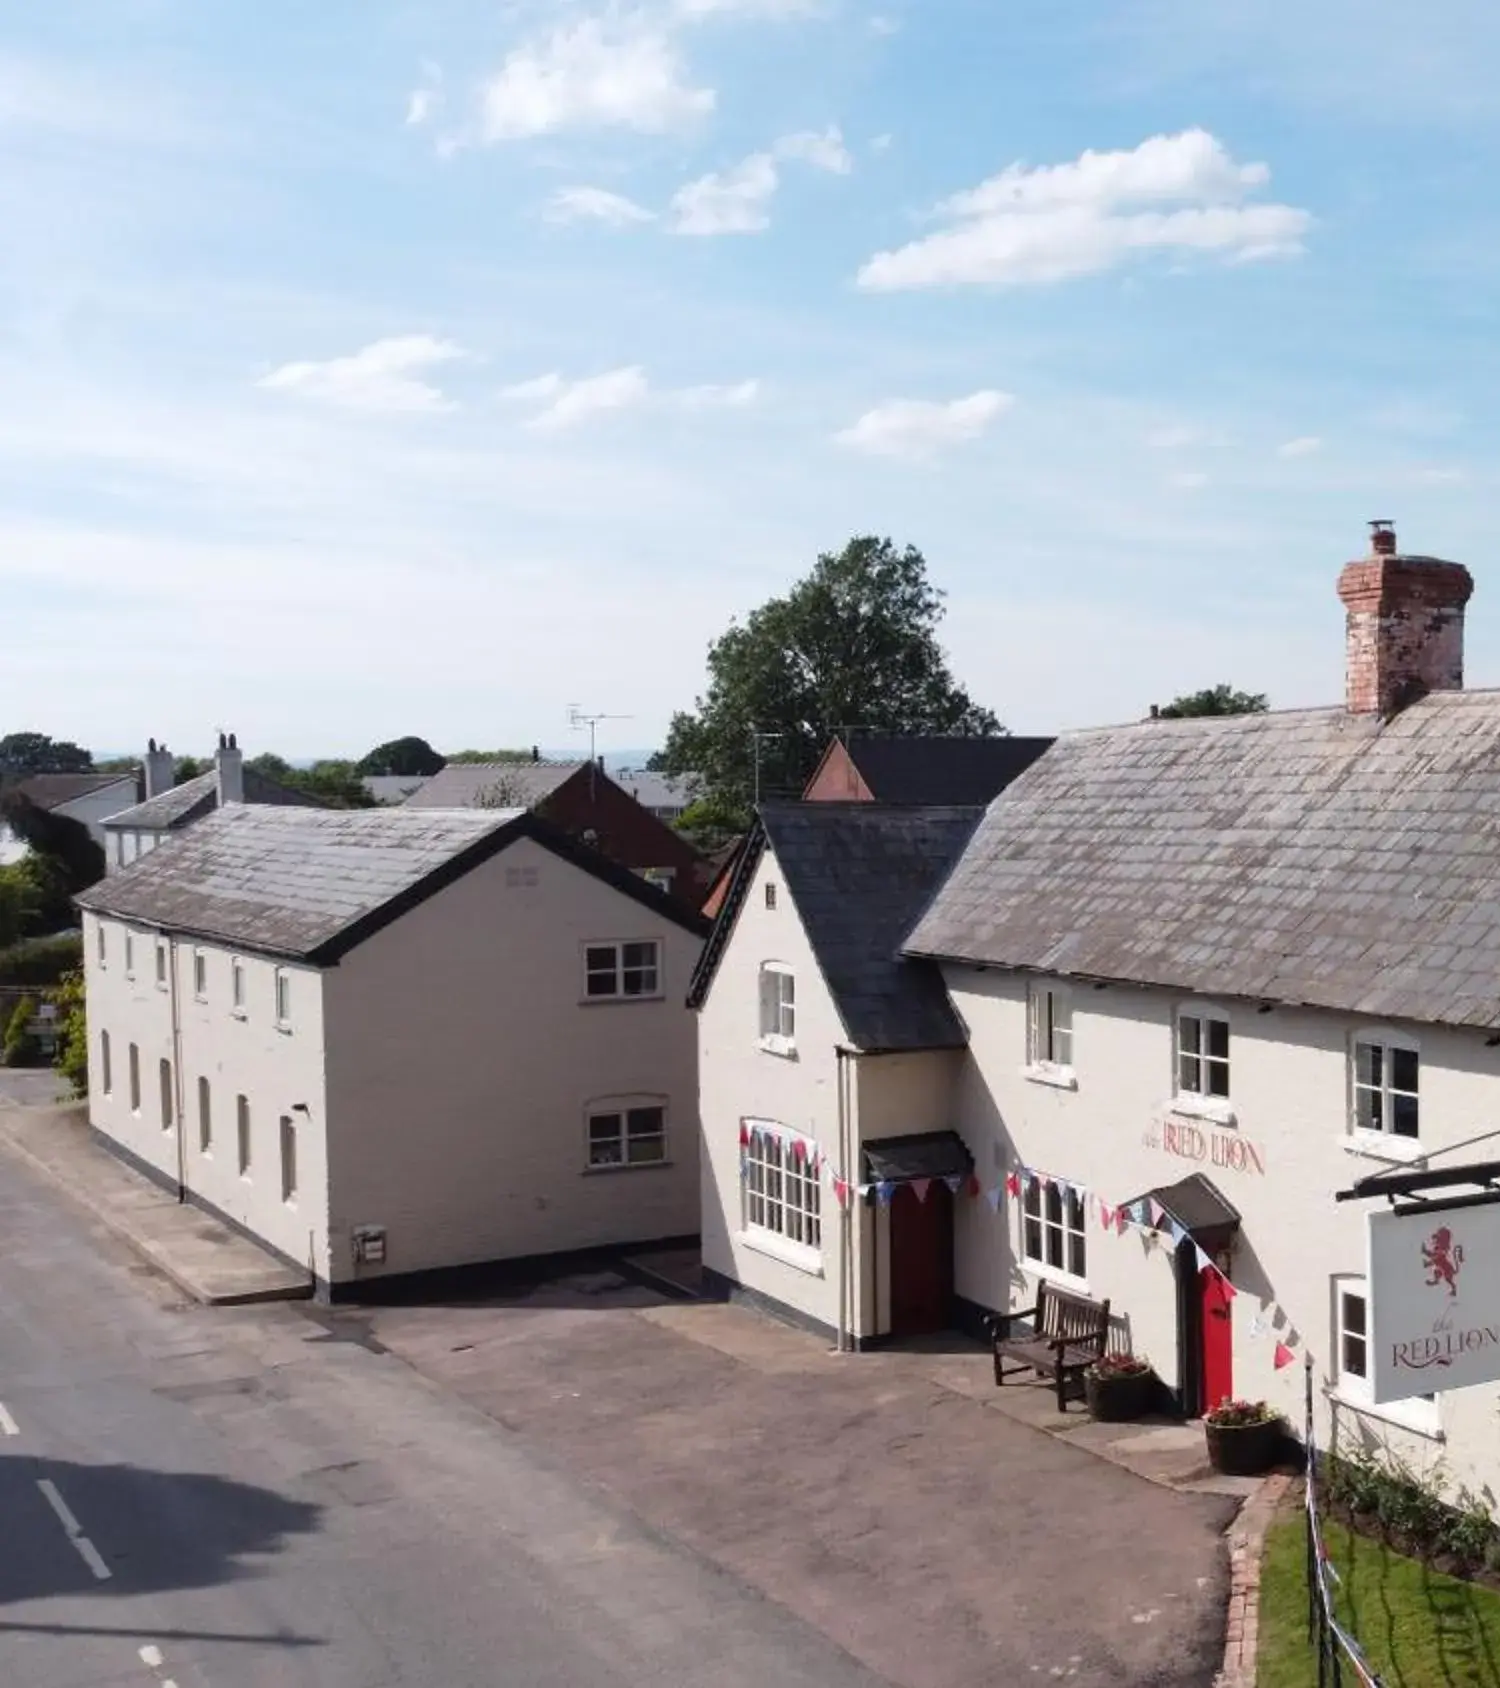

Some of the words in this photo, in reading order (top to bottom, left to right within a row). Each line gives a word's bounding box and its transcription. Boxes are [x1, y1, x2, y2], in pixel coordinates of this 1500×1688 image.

[1163, 1120, 1206, 1161] RED
[1210, 1133, 1266, 1176] LION
[1392, 1337, 1445, 1369] RED
